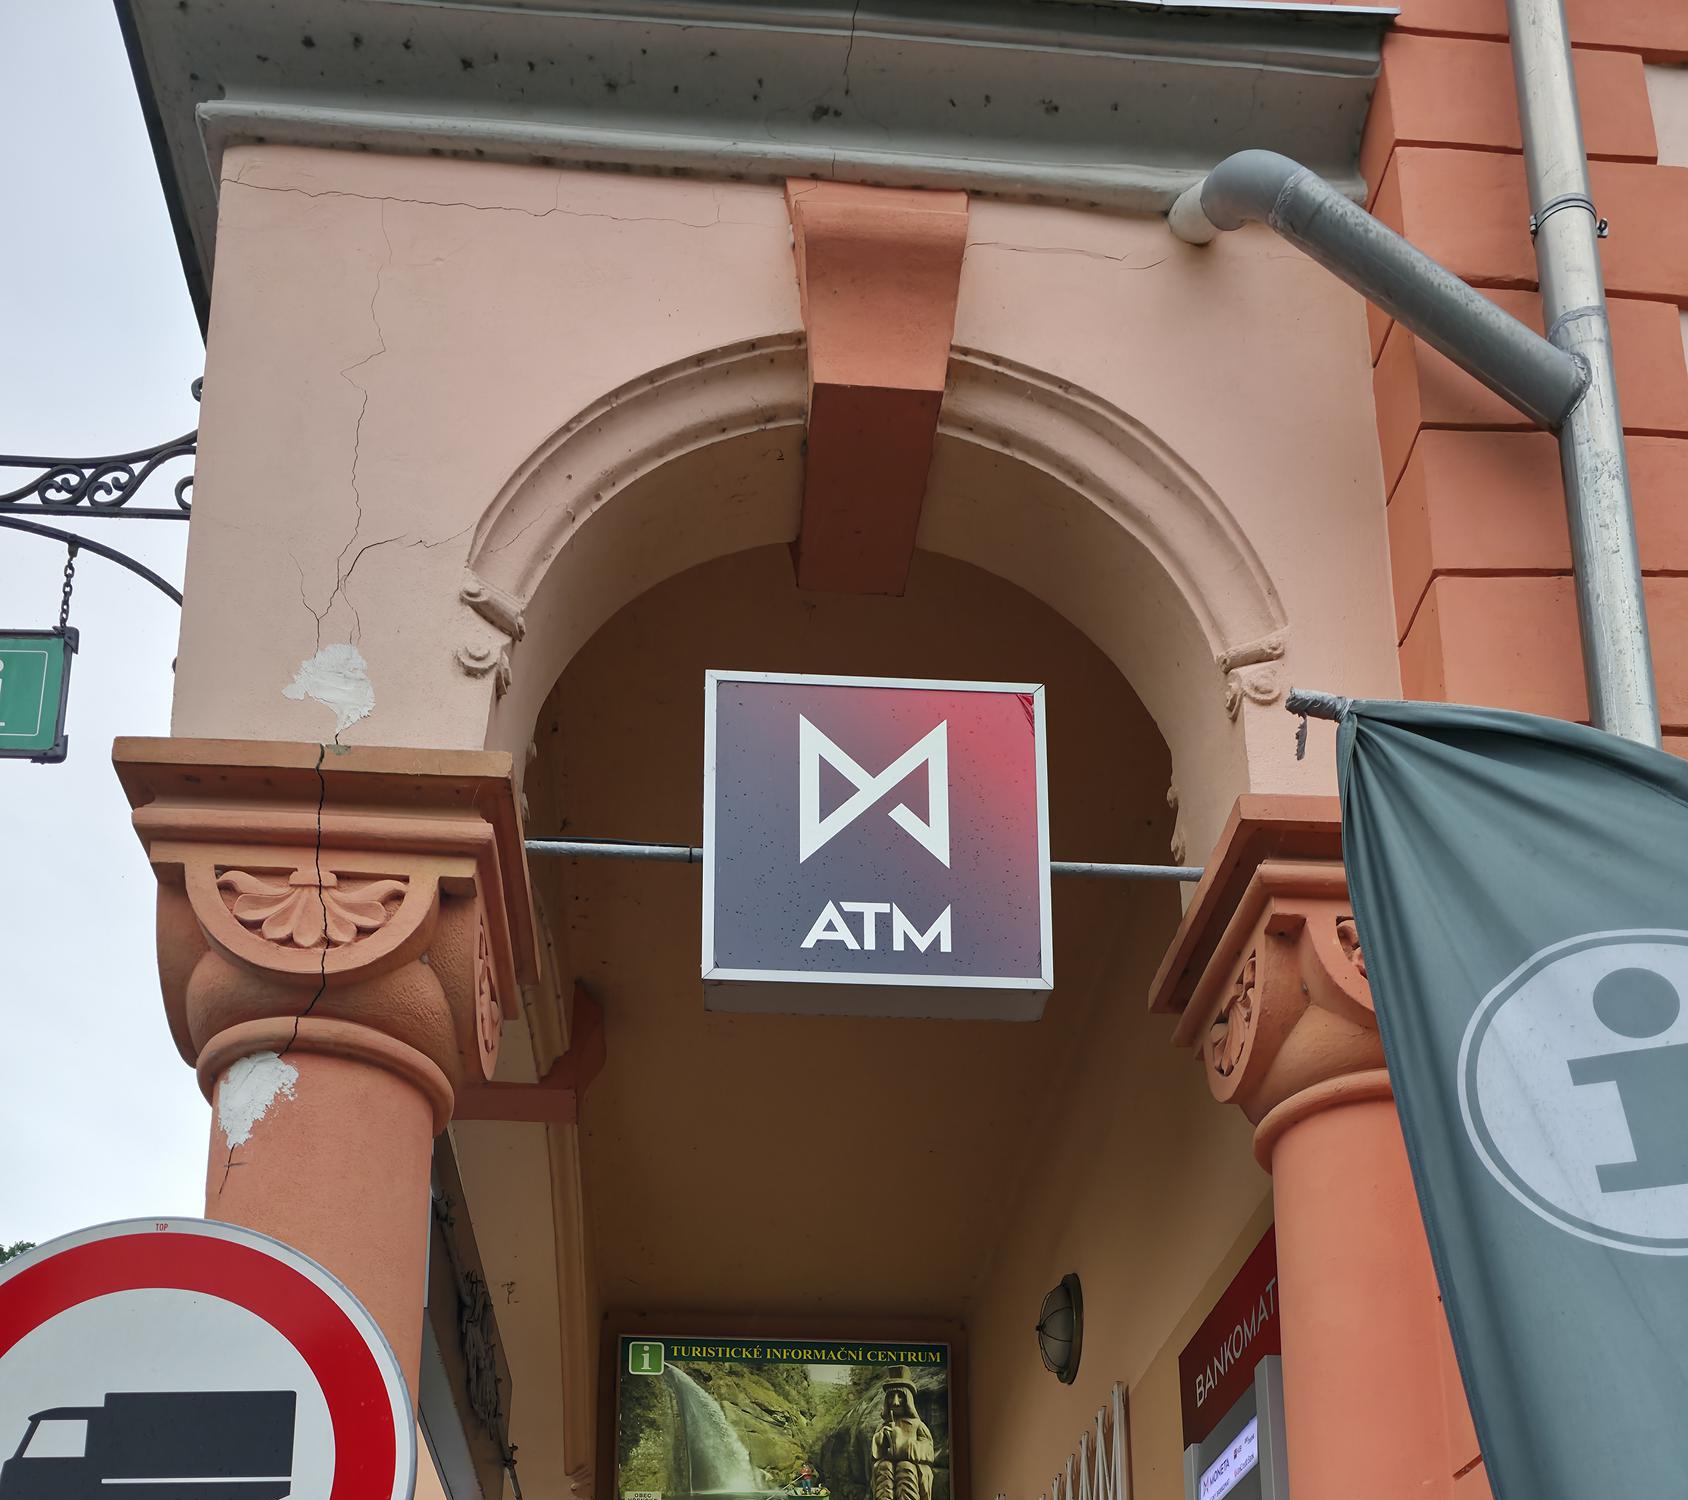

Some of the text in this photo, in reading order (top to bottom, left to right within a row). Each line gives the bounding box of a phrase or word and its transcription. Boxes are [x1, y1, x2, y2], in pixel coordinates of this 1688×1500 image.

[800, 899, 952, 953] ATM
[671, 1345, 941, 1362] TURISTICKÉ INFORMAČNÍ CENTRUM
[1195, 1277, 1276, 1408] BANKOMAT
